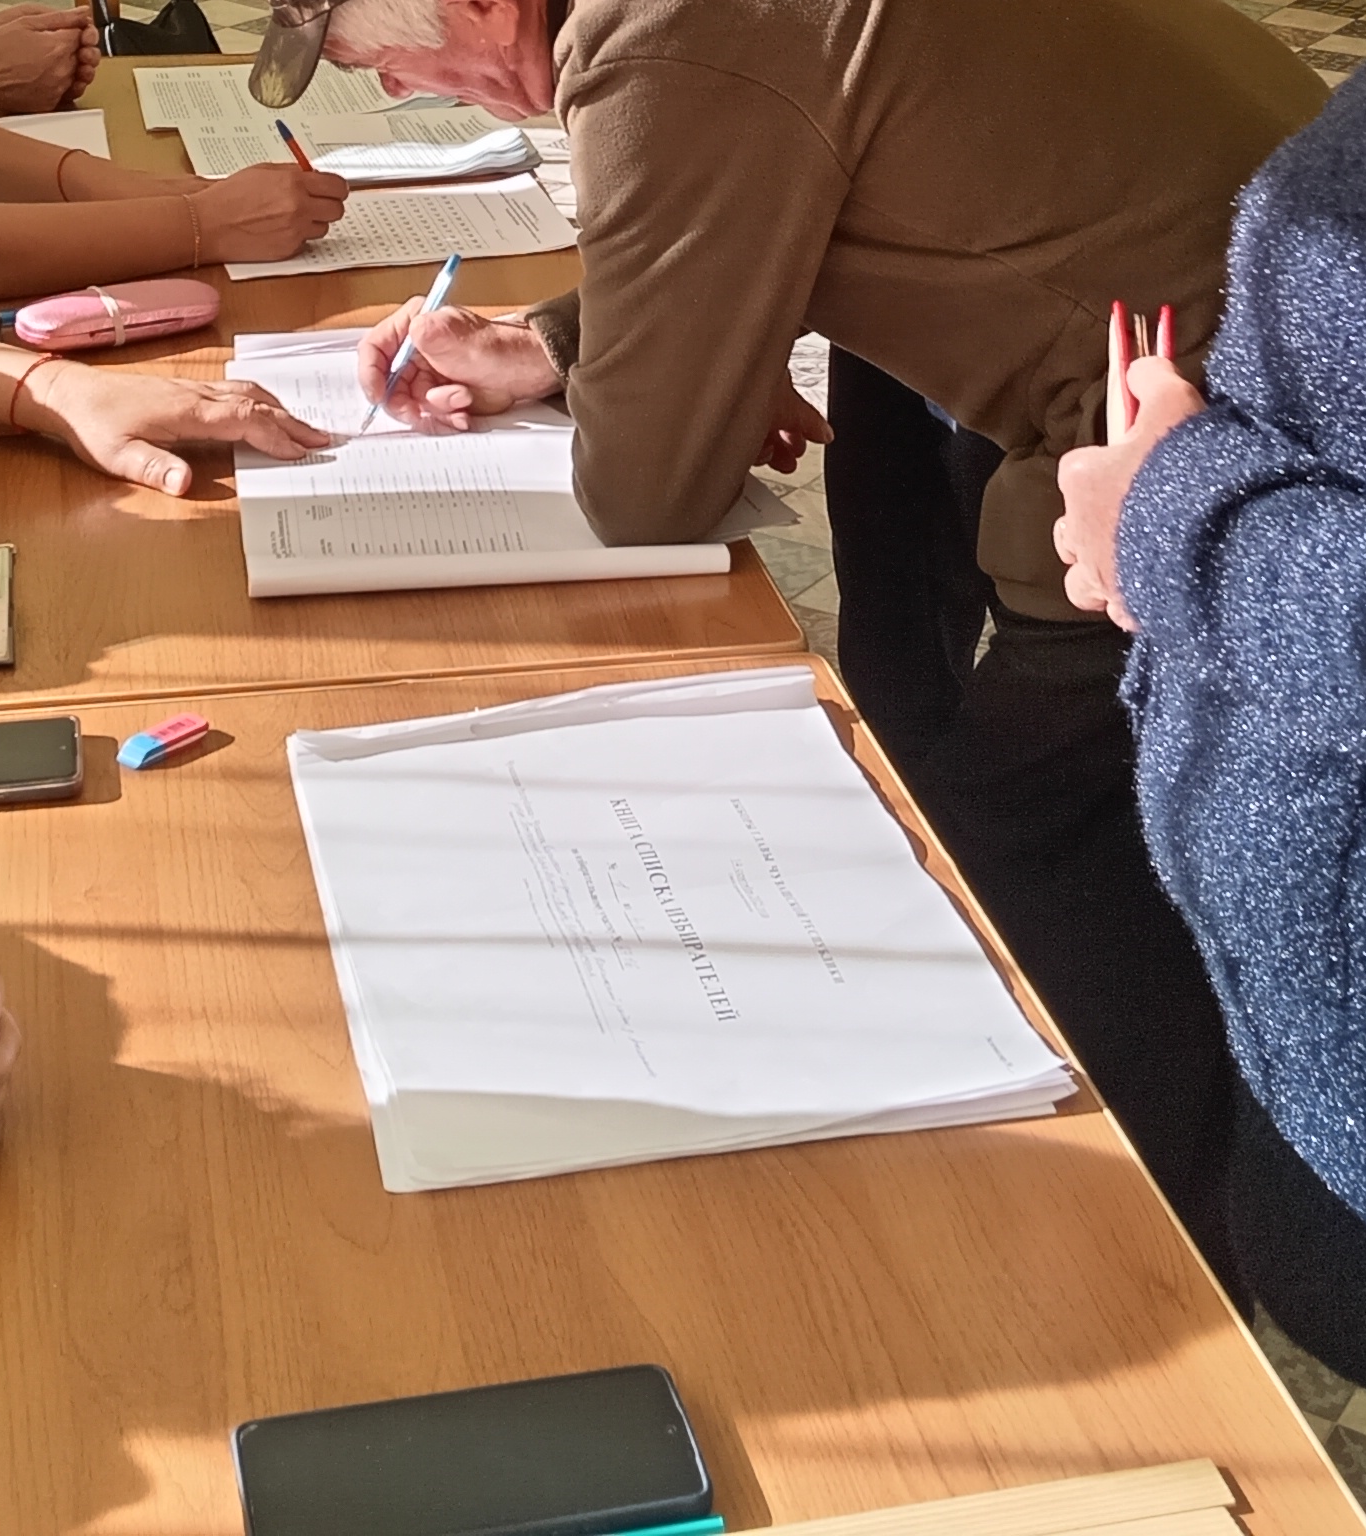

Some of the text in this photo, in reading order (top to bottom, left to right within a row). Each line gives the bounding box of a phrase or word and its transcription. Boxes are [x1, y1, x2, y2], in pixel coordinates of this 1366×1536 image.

[610, 798, 644, 841] КНИГА
[635, 842, 675, 906] СПИСКА
[665, 907, 741, 1022] ИЗБИРАТЕЛЕЙ
